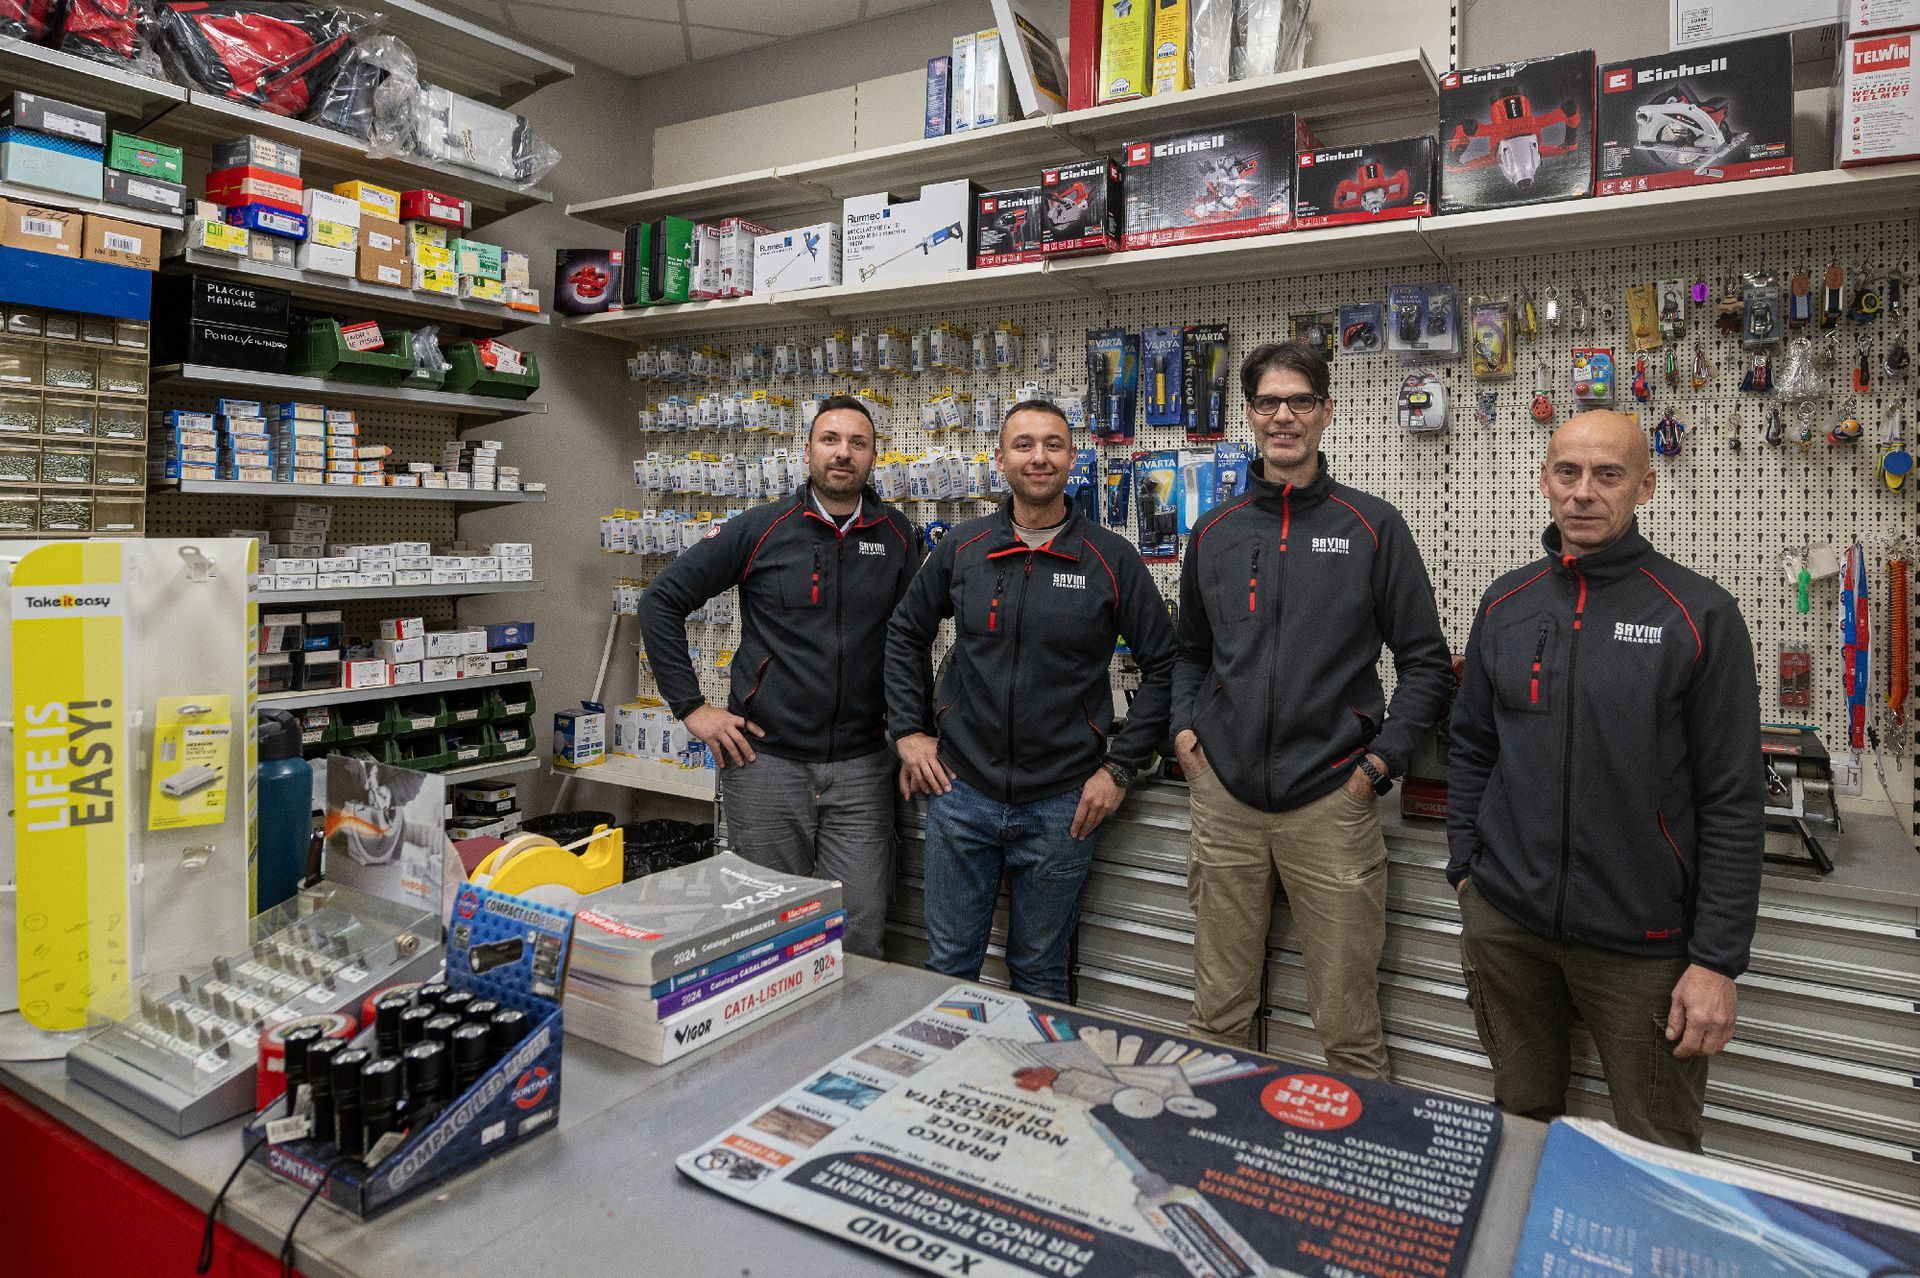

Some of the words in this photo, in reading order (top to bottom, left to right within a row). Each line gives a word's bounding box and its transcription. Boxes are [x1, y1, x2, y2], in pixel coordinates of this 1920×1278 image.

[1462, 69, 1516, 85] Einhell
[1637, 57, 1727, 84] Einhell
[1852, 85, 1909, 97] WELDING
[1852, 91, 1909, 103] HELMET
[1154, 135, 1225, 158] Einhell
[1315, 150, 1363, 163] Einhell
[1060, 165, 1104, 181] Einhell
[998, 195, 1042, 209] Einhell
[207, 283, 256, 299] PLACCHE
[207, 295, 257, 309] MANIGLIE
[1095, 337, 1123, 348] VARTA
[1145, 340, 1180, 351] VARTA
[1195, 331, 1225, 342] VARTA
[1143, 459, 1176, 470] VARTA
[1218, 452, 1246, 460] VARTA
[1068, 475, 1090, 485] RTA
[859, 541, 885, 553] SAVINI
[1312, 537, 1350, 549] SAVINI
[1053, 572, 1086, 586] SAVINI
[1613, 634, 1662, 645] FERRAMENTA
[1614, 622, 1664, 639] SAVINI
[25, 702, 68, 738] IS
[68, 698, 114, 827] EASY!
[26, 748, 69, 833] LIFE
[484, 898, 524, 921] COMPACT
[722, 884, 796, 911] 2024
[673, 949, 697, 966] 2024
[702, 936, 731, 953] Catalogo
[730, 919, 776, 946] FERRAMENTA
[710, 973, 739, 991] Catalogo
[738, 954, 779, 979] CASALINGHI
[674, 1018, 713, 1046] VIGOR
[813, 954, 836, 974] 2024
[1274, 1089, 1348, 1117] PP-PE
[1287, 1078, 1350, 1103] PTFE
[796, 1103, 833, 1121] LEGNO
[904, 1087, 1015, 1130] NECESSITA
[940, 1088, 1026, 1121] PISTOLA
[1424, 1098, 1495, 1122] METALLO
[387, 1107, 474, 1191] COMPACT
[474, 1073, 506, 1110] LED
[925, 1112, 1010, 1148] VELOCE
[1028, 1115, 1054, 1129] DI
[1413, 1106, 1492, 1133] CERAMICA
[906, 1124, 1002, 1164] PRATICO
[1015, 1124, 1069, 1148] NON
[1432, 1135, 1485, 1156] VETRO
[1433, 1123, 1489, 1145] PIETRA
[1187, 1126, 1469, 1213] ACRILONITRILE-BUTADIENE-STIRENE
[1281, 1141, 1369, 1173] POLIVINILE
[1283, 1130, 1475, 1189] POLIMETILMETACRILATO
[1344, 1136, 1479, 1178] POLICARBONATO
[1426, 1145, 1482, 1167] LEGNO
[826, 1159, 916, 1199] ESTREMI
[1233, 1151, 1391, 1205] ETILENE-PROPILENE
[1371, 1166, 1390, 1179] DI
[1391, 1172, 1472, 1201] CLORURO
[809, 1170, 978, 1240] BICOMPONENTE
[911, 1189, 1048, 1248] INCOLLAGGI
[1394, 1197, 1464, 1226] GOMMA
[1337, 1222, 1452, 1263] POLIETILENE
[1343, 1210, 1456, 1249] POLIETILENE
[846, 1216, 983, 1276] X-BOND
[975, 1230, 1085, 1278] ADESIVO
[1046, 1237, 1095, 1265] PER
[1330, 1236, 1447, 1278] POLIETILENE
